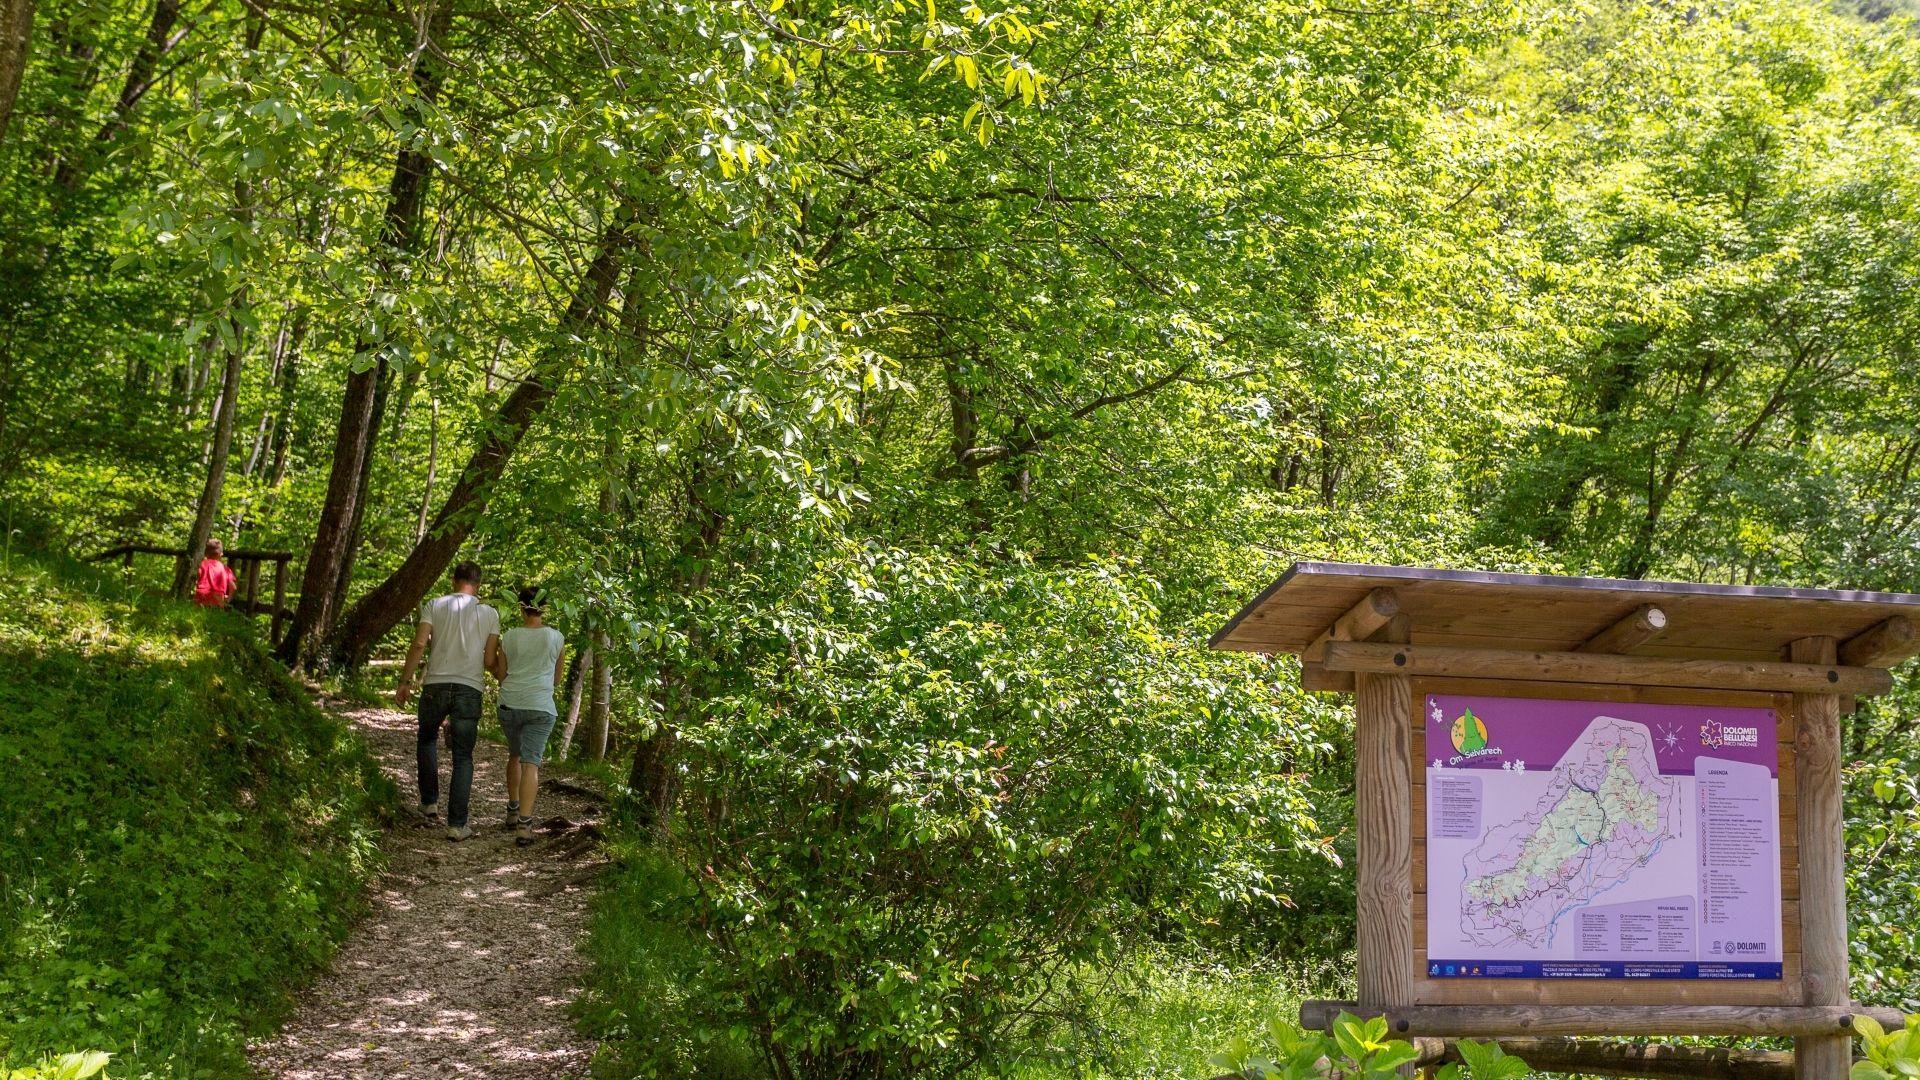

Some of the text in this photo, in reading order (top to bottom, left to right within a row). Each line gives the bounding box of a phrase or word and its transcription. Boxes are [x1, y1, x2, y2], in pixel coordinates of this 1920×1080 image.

[1723, 734, 1757, 742] BELLUNESI
[1449, 755, 1463, 765] Om
[1736, 942, 1766, 950] DOLOMITI
